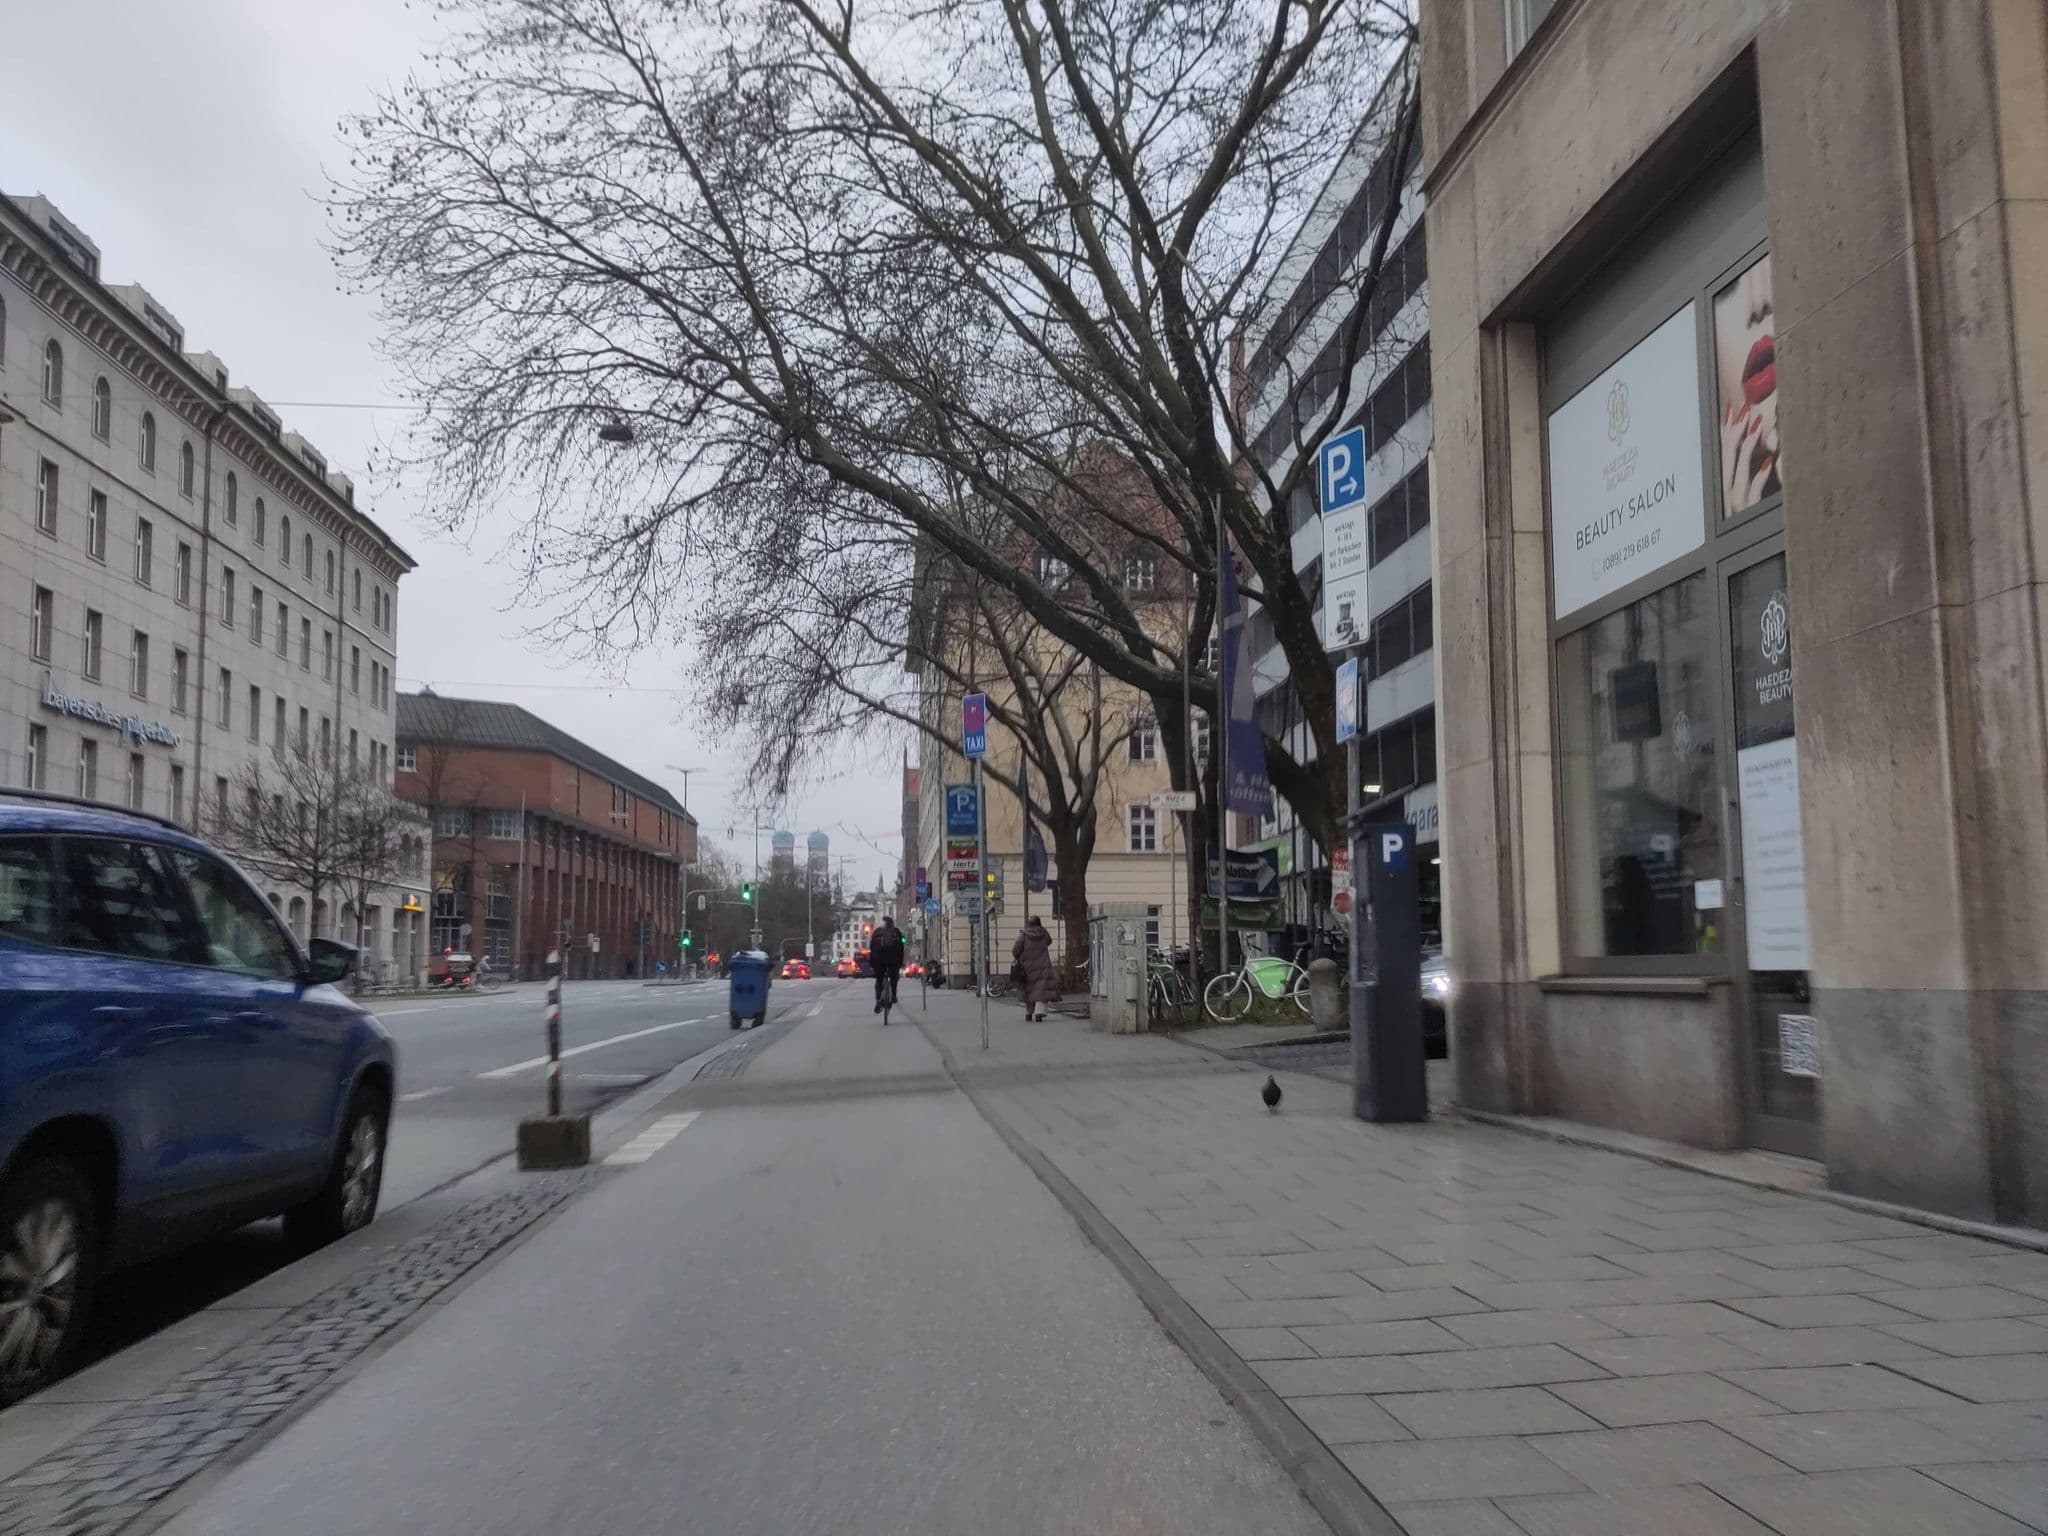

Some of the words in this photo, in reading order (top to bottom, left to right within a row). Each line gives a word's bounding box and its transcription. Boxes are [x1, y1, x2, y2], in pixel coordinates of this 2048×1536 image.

[1327, 444, 1350, 503] P
[1576, 505, 1624, 551] BEAUTY
[1628, 473, 1675, 519] SALON
[1602, 551, 1621, 574] (089)
[1623, 543, 1635, 561] 219
[1636, 535, 1649, 553] 618
[1650, 528, 1661, 545] 67
[1760, 683, 1792, 705] BEAUTY
[966, 735, 984, 751] TAXI
[1382, 833, 1403, 863] P
[952, 861, 975, 869] Hertz
